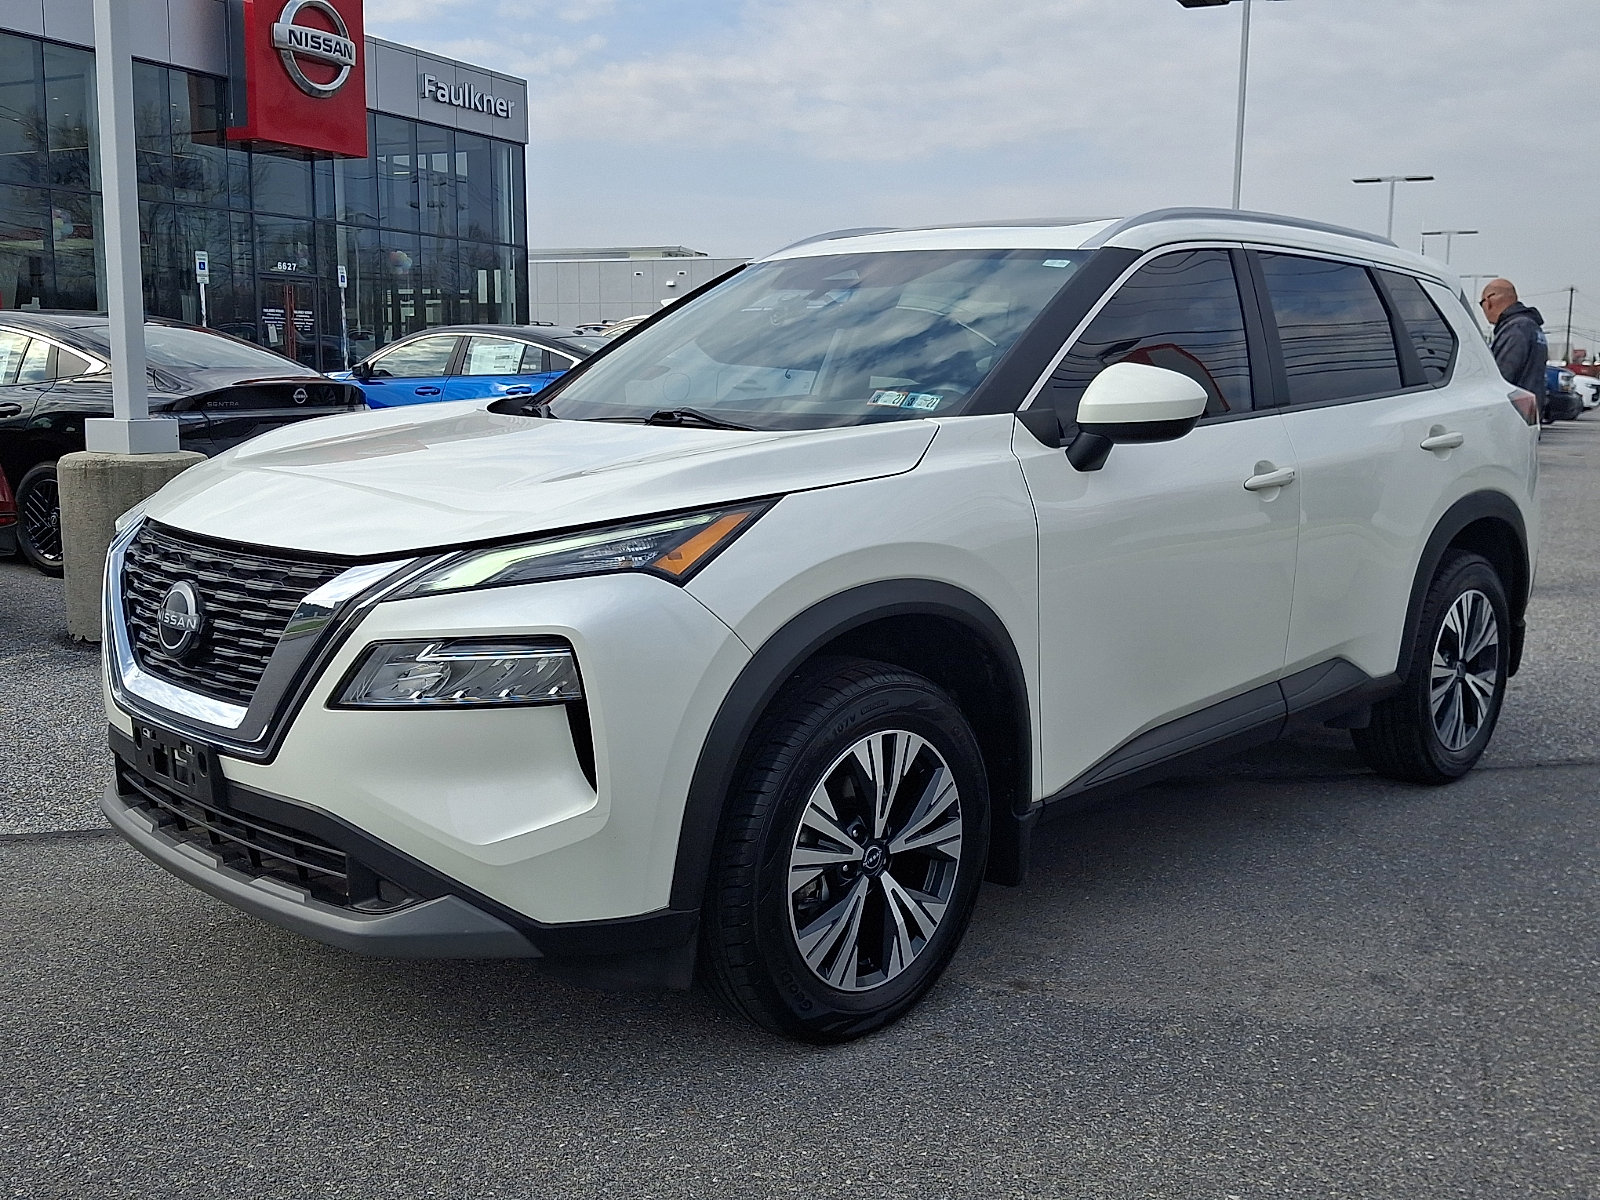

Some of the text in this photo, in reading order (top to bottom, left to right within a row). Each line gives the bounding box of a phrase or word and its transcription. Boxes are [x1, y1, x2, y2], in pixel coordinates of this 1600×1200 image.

[288, 29, 353, 60] NISSAN
[422, 73, 515, 118] Faulkner
[277, 261, 297, 271] 6627
